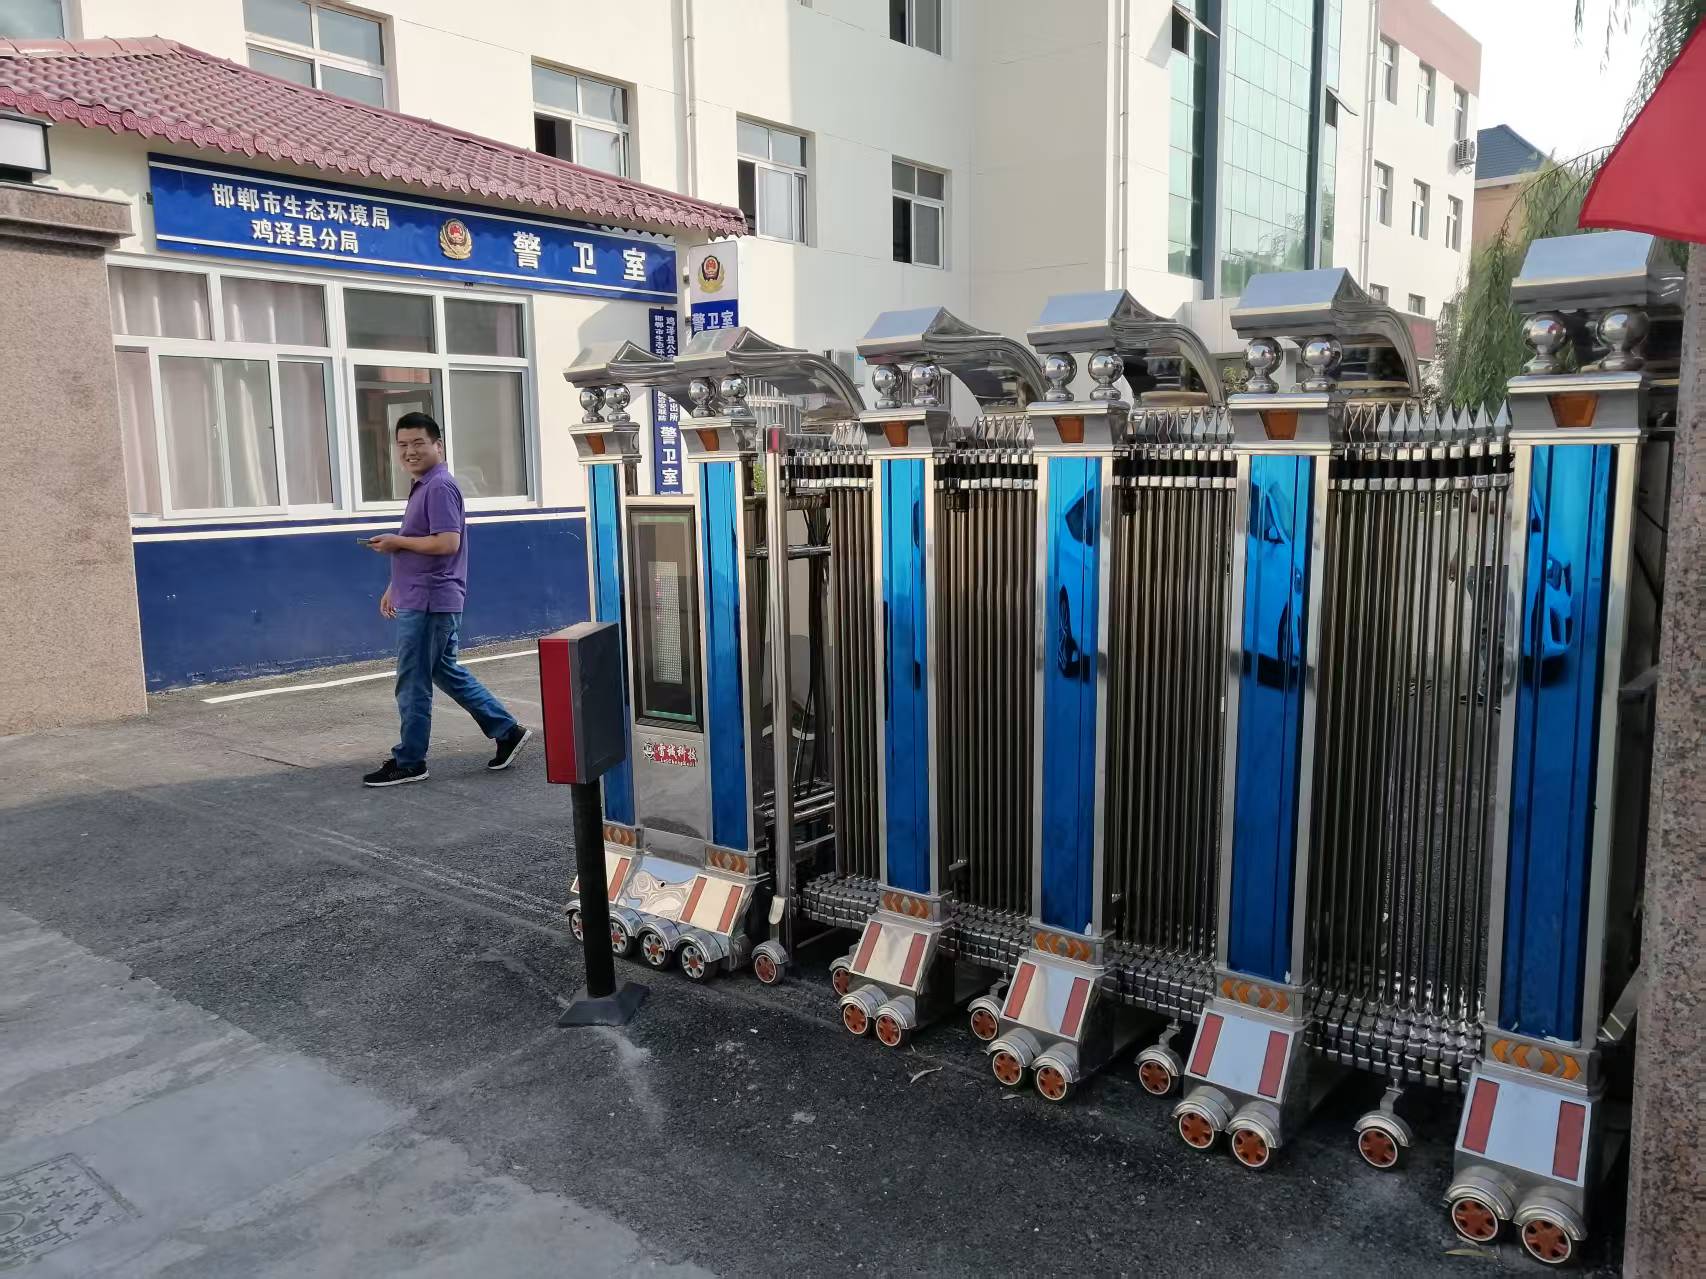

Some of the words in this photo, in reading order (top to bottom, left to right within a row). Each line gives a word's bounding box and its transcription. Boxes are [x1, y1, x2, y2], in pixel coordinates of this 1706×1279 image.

[212, 183, 390, 230] 邯郸市生态环境局
[251, 219, 359, 253] 鸡泽县分局
[513, 230, 647, 282] 警卫室
[692, 310, 735, 332] 警卫室
[660, 426, 679, 486] 警卫室
